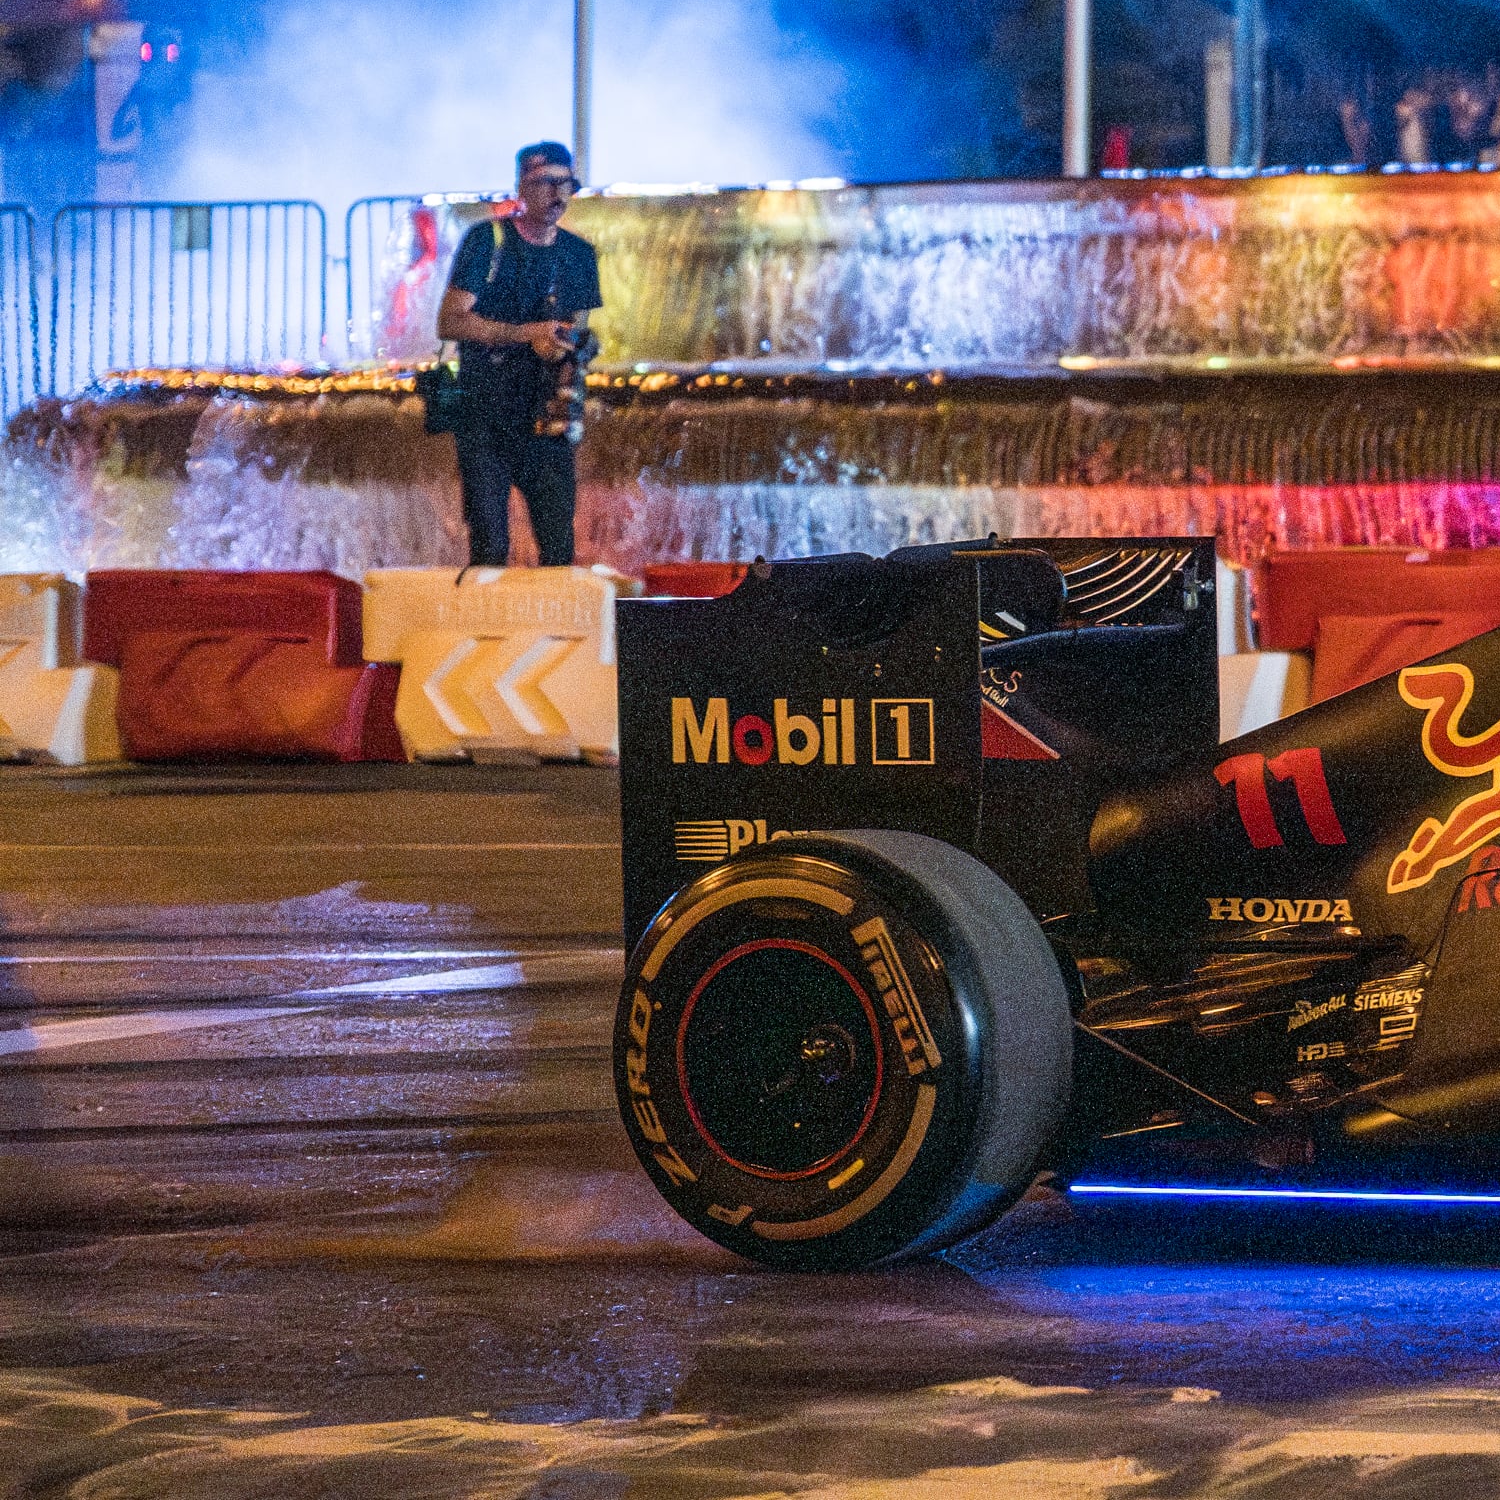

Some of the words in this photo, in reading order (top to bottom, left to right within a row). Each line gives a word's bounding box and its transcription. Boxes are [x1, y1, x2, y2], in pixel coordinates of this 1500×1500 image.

[671, 697, 857, 765] Mobil
[889, 705, 912, 758] 1
[1213, 747, 1348, 849] 11
[1205, 897, 1354, 923] HONDA
[1352, 988, 1424, 1012] SIEMENS
[625, 988, 699, 1187] ZERO
